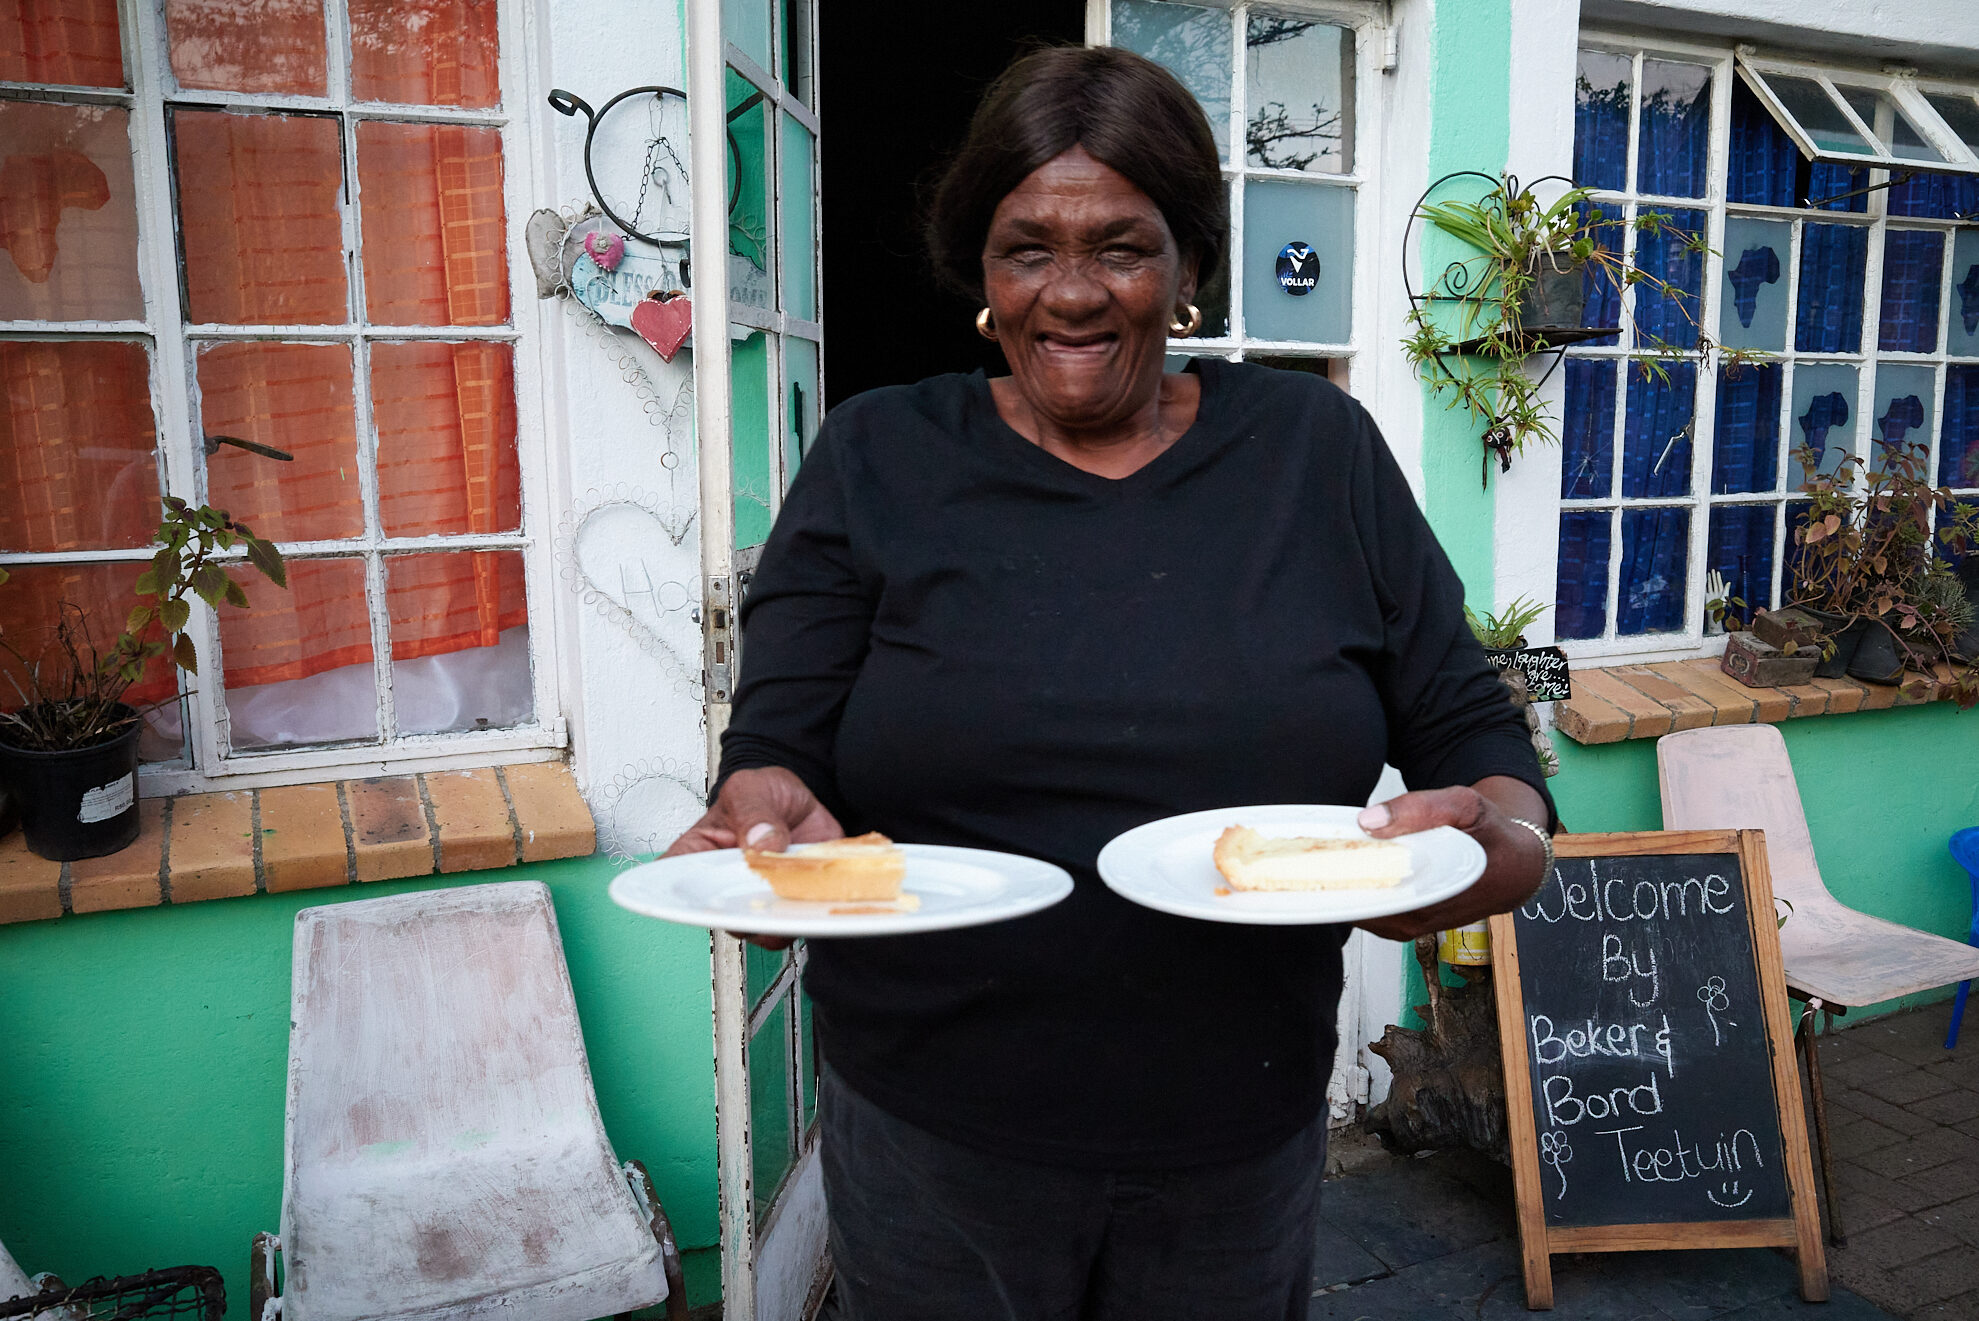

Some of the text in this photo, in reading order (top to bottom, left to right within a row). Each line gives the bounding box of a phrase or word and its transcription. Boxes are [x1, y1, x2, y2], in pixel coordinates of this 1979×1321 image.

[1280, 277, 1315, 287] VOLLAR
[1513, 651, 1567, 675] laughter
[1525, 679, 1569, 695] come!
[1521, 859, 1735, 923] Welcome
[1603, 934, 1659, 1008] By
[1531, 1014, 1675, 1079] Beker &
[1542, 1071, 1663, 1127] Bord
[1594, 1126, 1764, 1183] Teetuin
